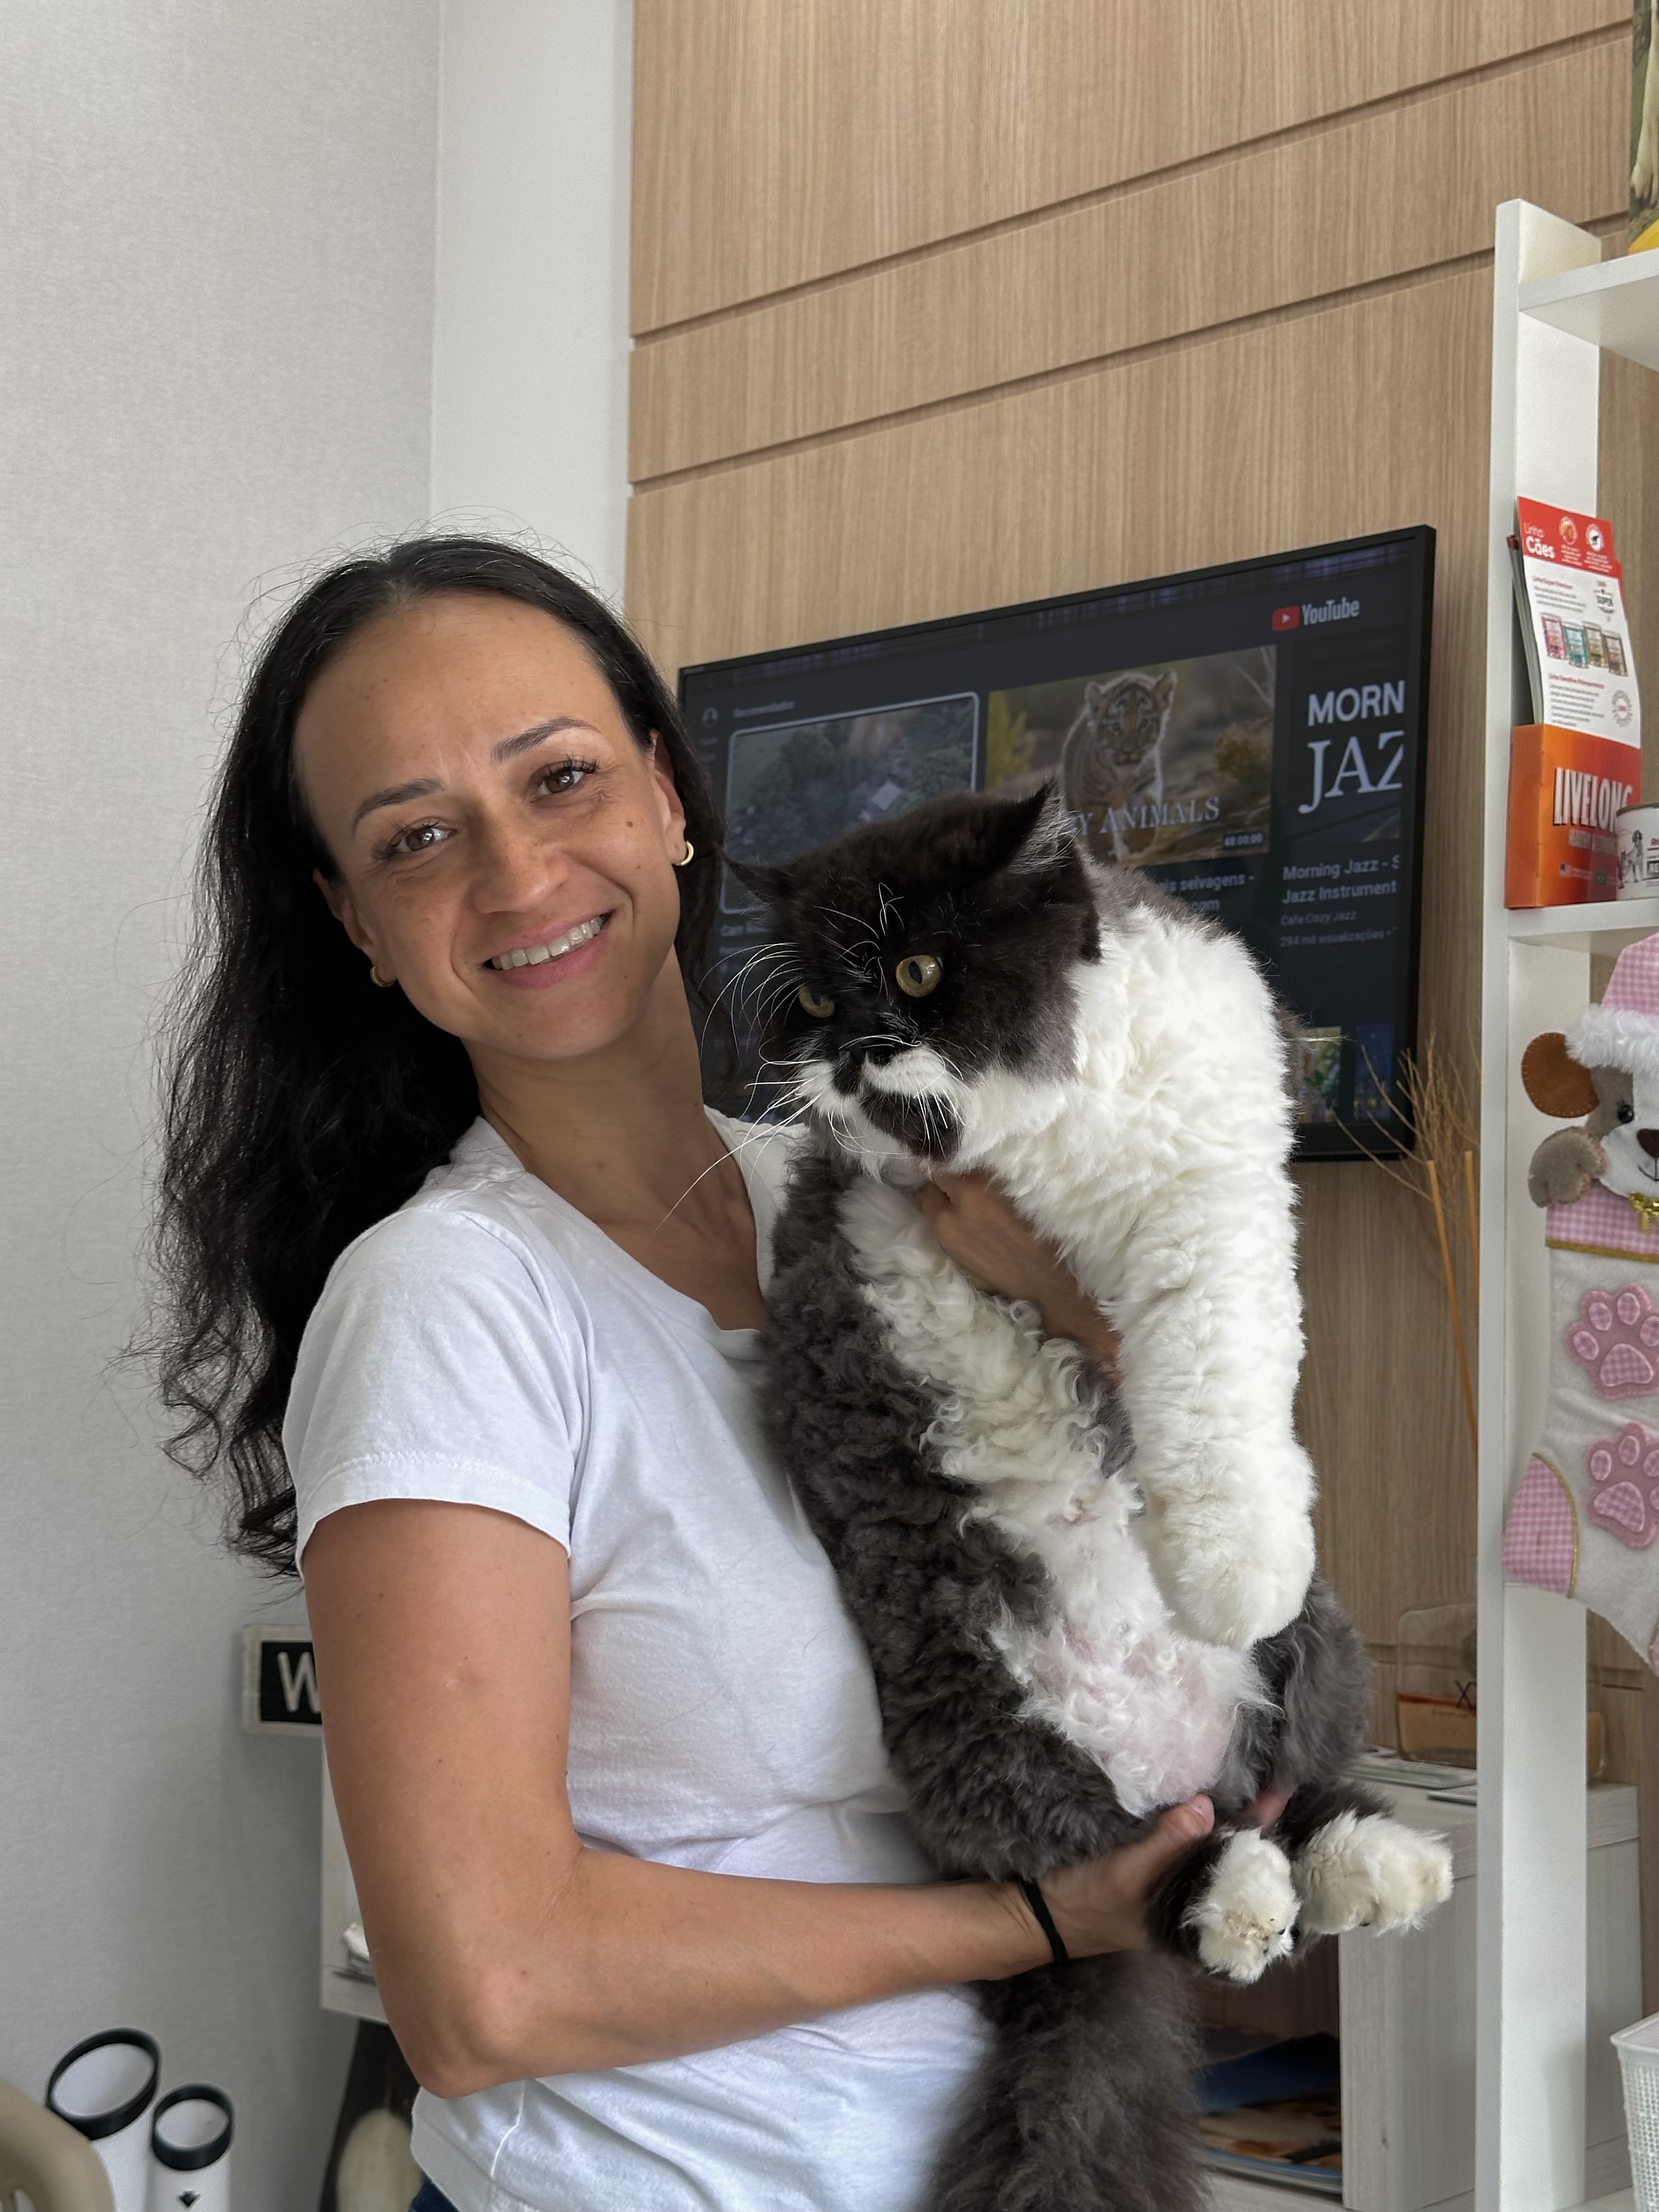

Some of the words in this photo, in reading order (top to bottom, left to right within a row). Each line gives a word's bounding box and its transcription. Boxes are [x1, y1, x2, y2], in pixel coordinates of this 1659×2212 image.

[1525, 535, 1556, 558] Cães
[1302, 596, 1360, 625] YouTube
[1308, 680, 1405, 726] MORN
[1299, 730, 1404, 814] JAZ
[1099, 797, 1220, 834] ANIMALS
[1180, 873, 1246, 891] selvagens
[1283, 862, 1340, 880] Morning
[1344, 859, 1379, 874] Jazz
[1282, 889, 1316, 904] Jazz
[1319, 879, 1398, 901] Instrument
